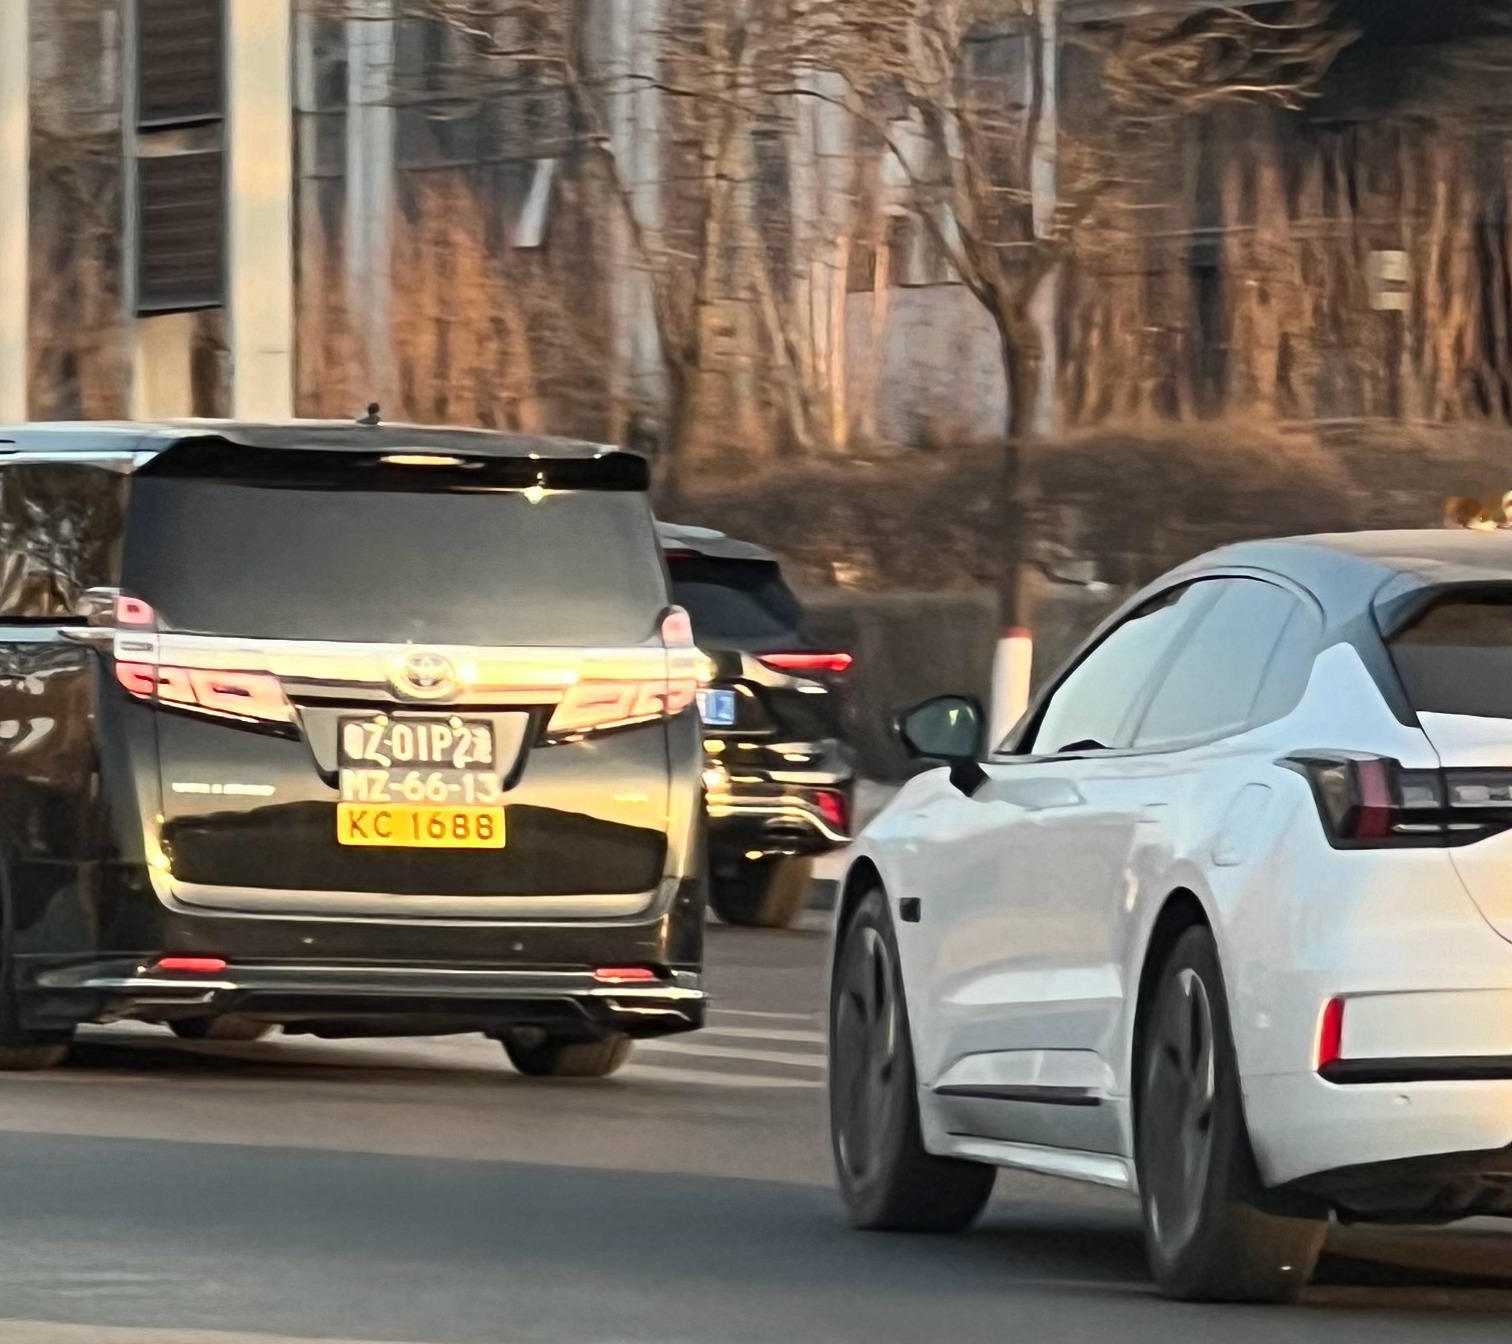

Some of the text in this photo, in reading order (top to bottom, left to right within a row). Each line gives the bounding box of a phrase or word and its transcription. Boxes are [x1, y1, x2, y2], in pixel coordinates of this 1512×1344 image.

[342, 769, 501, 804] MZ-66-13
[349, 810, 495, 841] KC 1688
